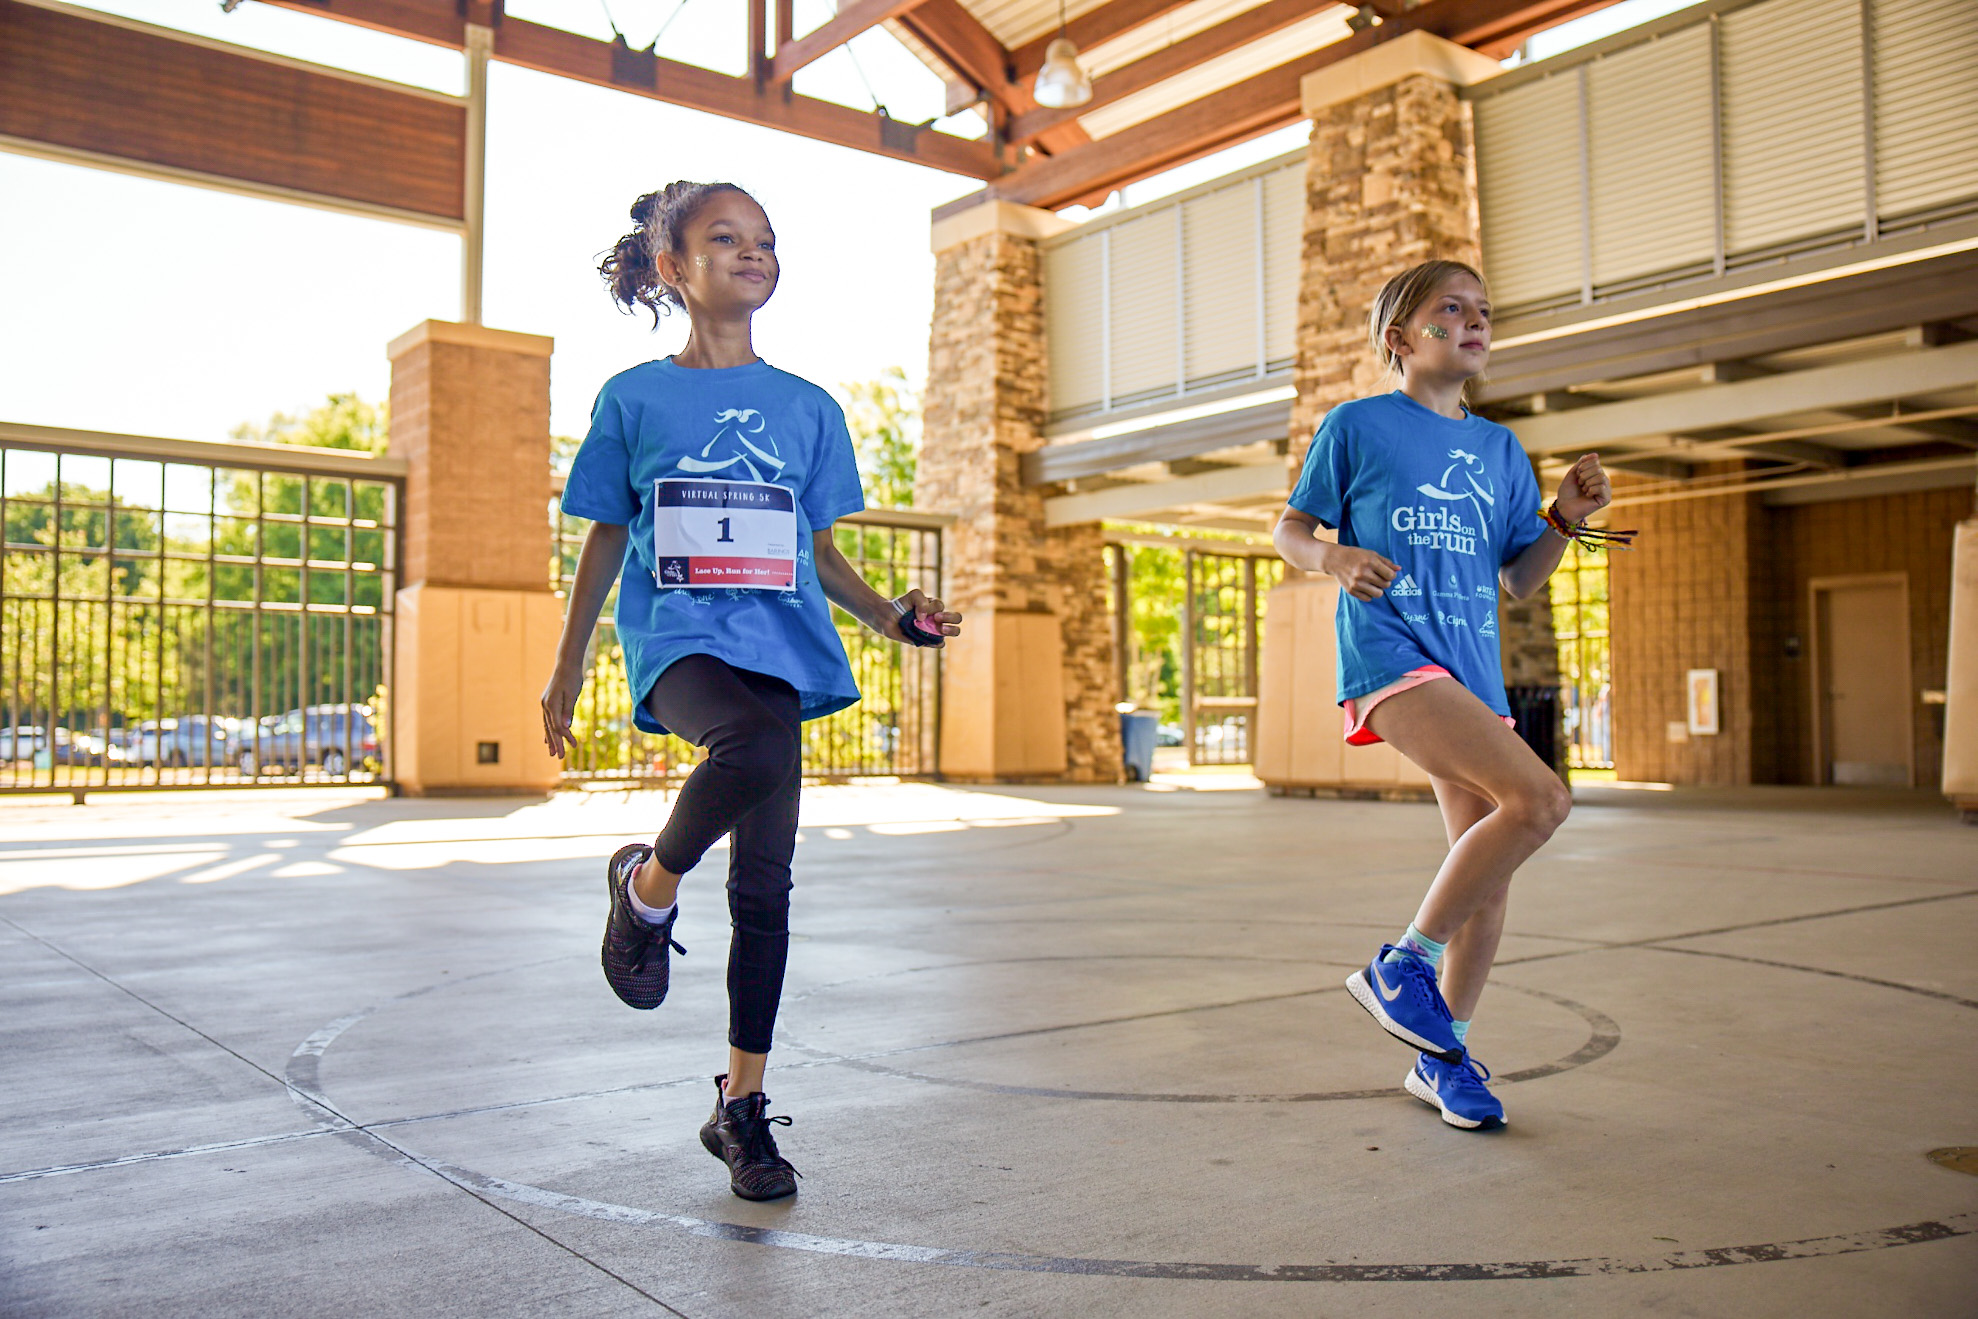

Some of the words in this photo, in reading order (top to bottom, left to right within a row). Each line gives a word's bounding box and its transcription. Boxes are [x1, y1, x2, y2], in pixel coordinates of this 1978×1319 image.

[681, 490, 718, 500] VIRTUAL
[722, 491, 755, 502] SPRING
[759, 493, 770, 502] 5K
[717, 517, 734, 543] 1
[1391, 506, 1462, 533] Girls
[1461, 525, 1476, 536] on
[1408, 532, 1431, 546] the
[1429, 531, 1477, 556] run
[695, 567, 711, 575] Lace
[725, 567, 741, 575] Run
[742, 567, 752, 575] for
[754, 567, 770, 576] Her!
[1391, 588, 1423, 597] adidas
